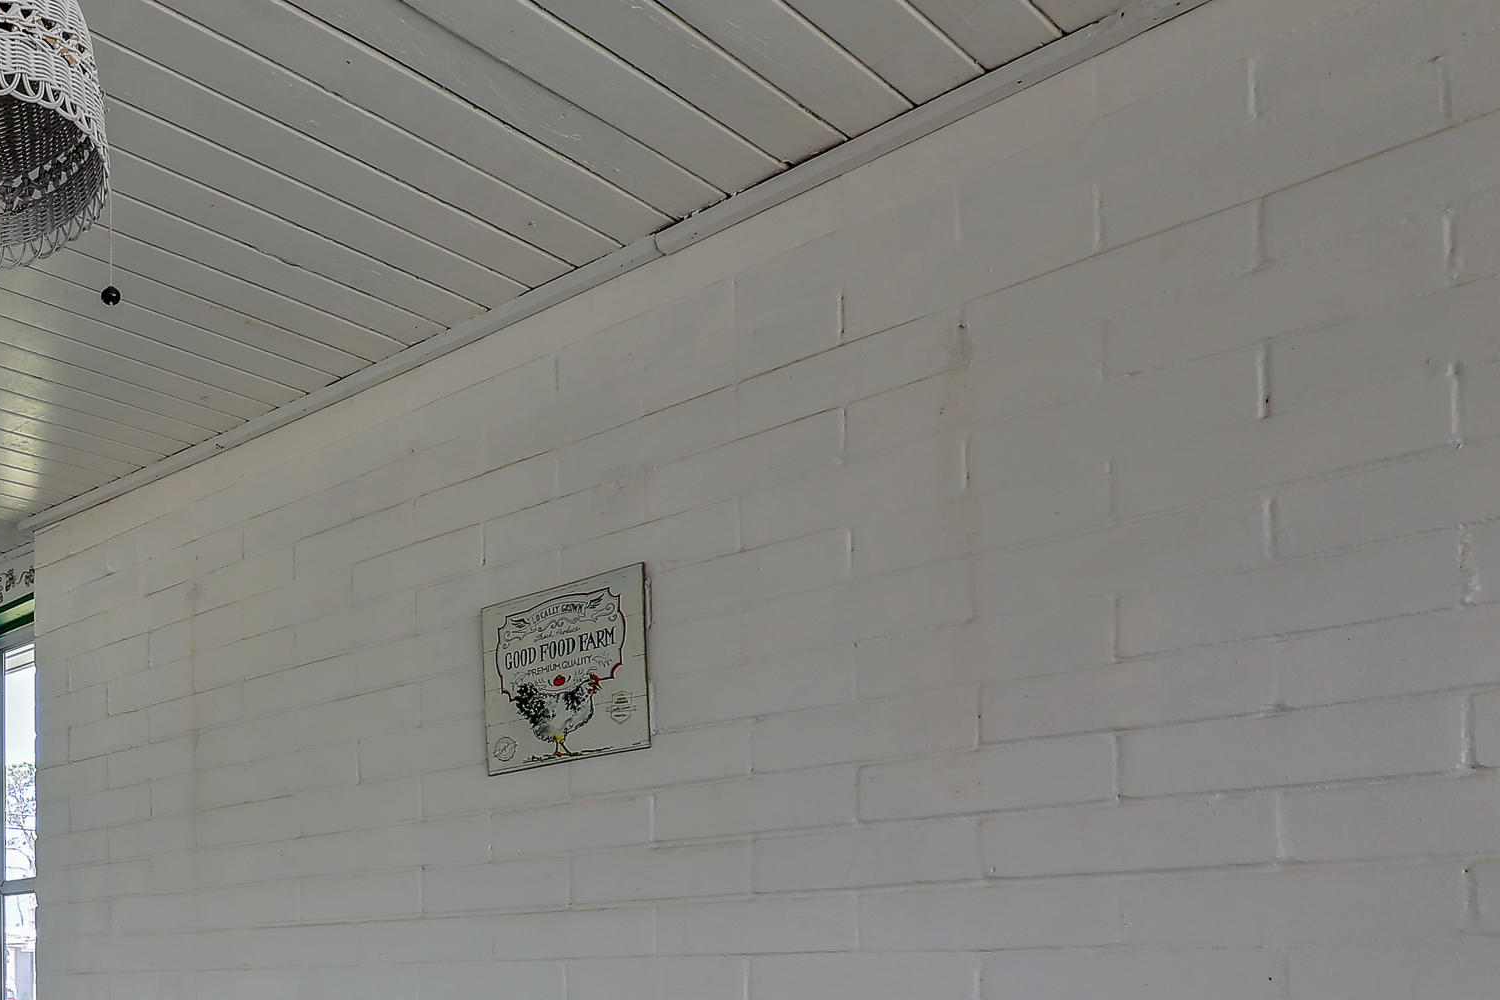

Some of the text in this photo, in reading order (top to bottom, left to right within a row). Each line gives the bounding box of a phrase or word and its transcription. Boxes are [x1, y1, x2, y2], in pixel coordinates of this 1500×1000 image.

[531, 602, 585, 624] LOCALLY GROWN
[504, 626, 616, 671] GOOD FOOD FARM
[527, 654, 593, 677] PREMIUM QUALITY
